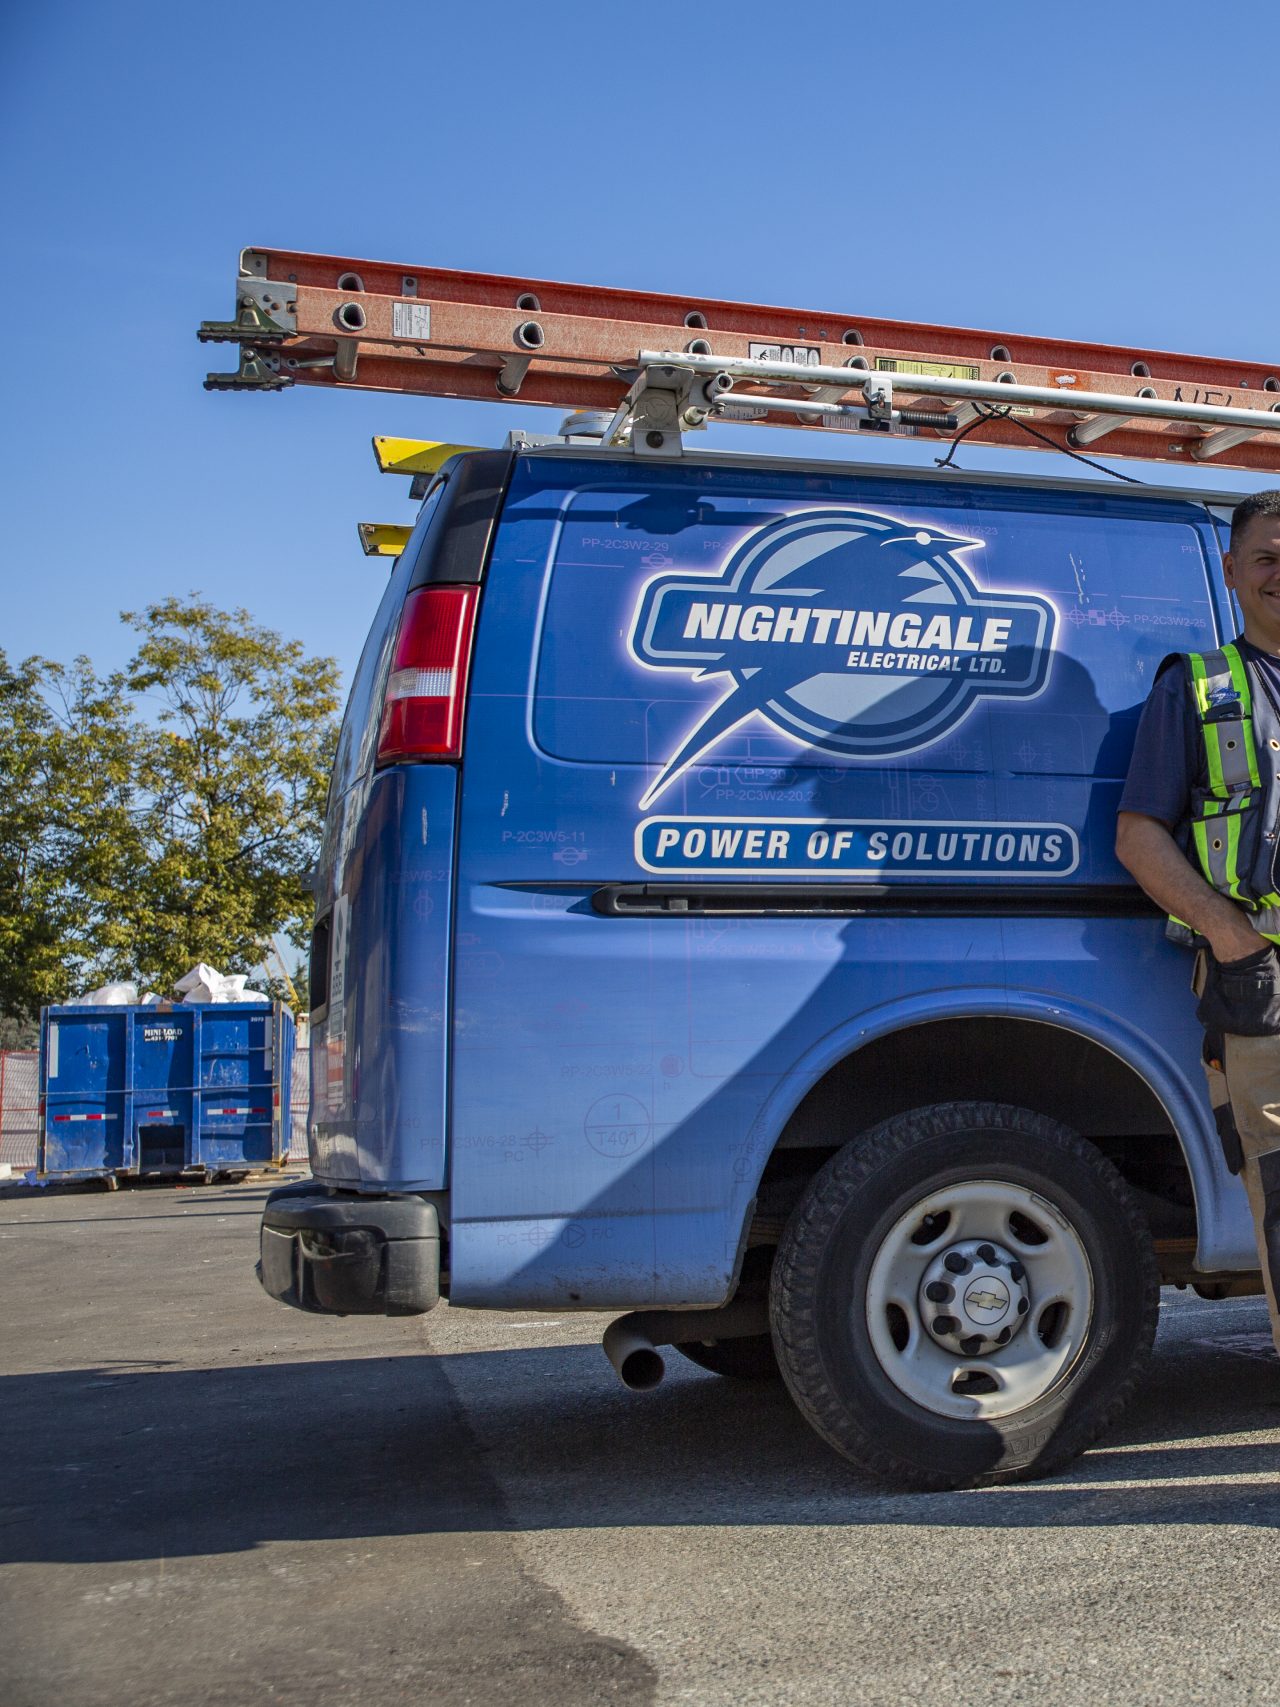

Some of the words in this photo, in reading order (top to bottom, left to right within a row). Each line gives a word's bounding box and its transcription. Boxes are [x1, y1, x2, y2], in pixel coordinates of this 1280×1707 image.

[682, 603, 1013, 652] NIGHTINGALE
[846, 651, 961, 673] ELECTRICAL
[969, 657, 1007, 675] LTD.
[655, 828, 791, 859] POWER
[806, 830, 855, 860] OF
[867, 831, 1064, 863] SOLUTIONS
